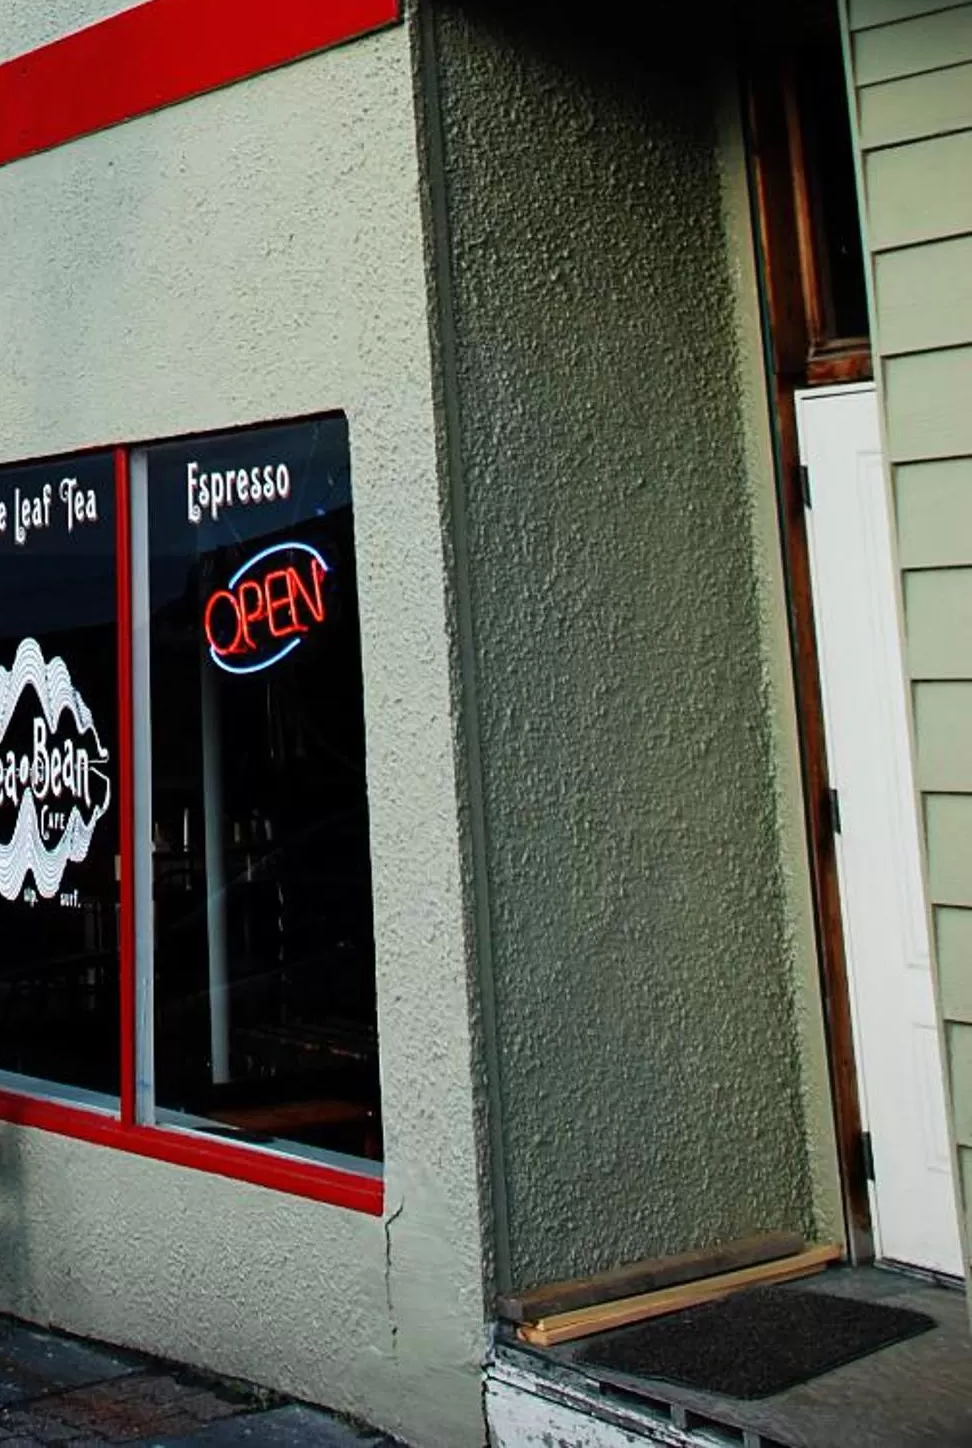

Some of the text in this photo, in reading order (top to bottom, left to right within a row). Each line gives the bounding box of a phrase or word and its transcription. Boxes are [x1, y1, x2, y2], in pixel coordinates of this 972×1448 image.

[13, 483, 52, 544] Leaf
[59, 477, 99, 533] Tea
[186, 461, 290, 523] Espresso
[204, 558, 326, 656] OPEN
[31, 716, 92, 808] Bean
